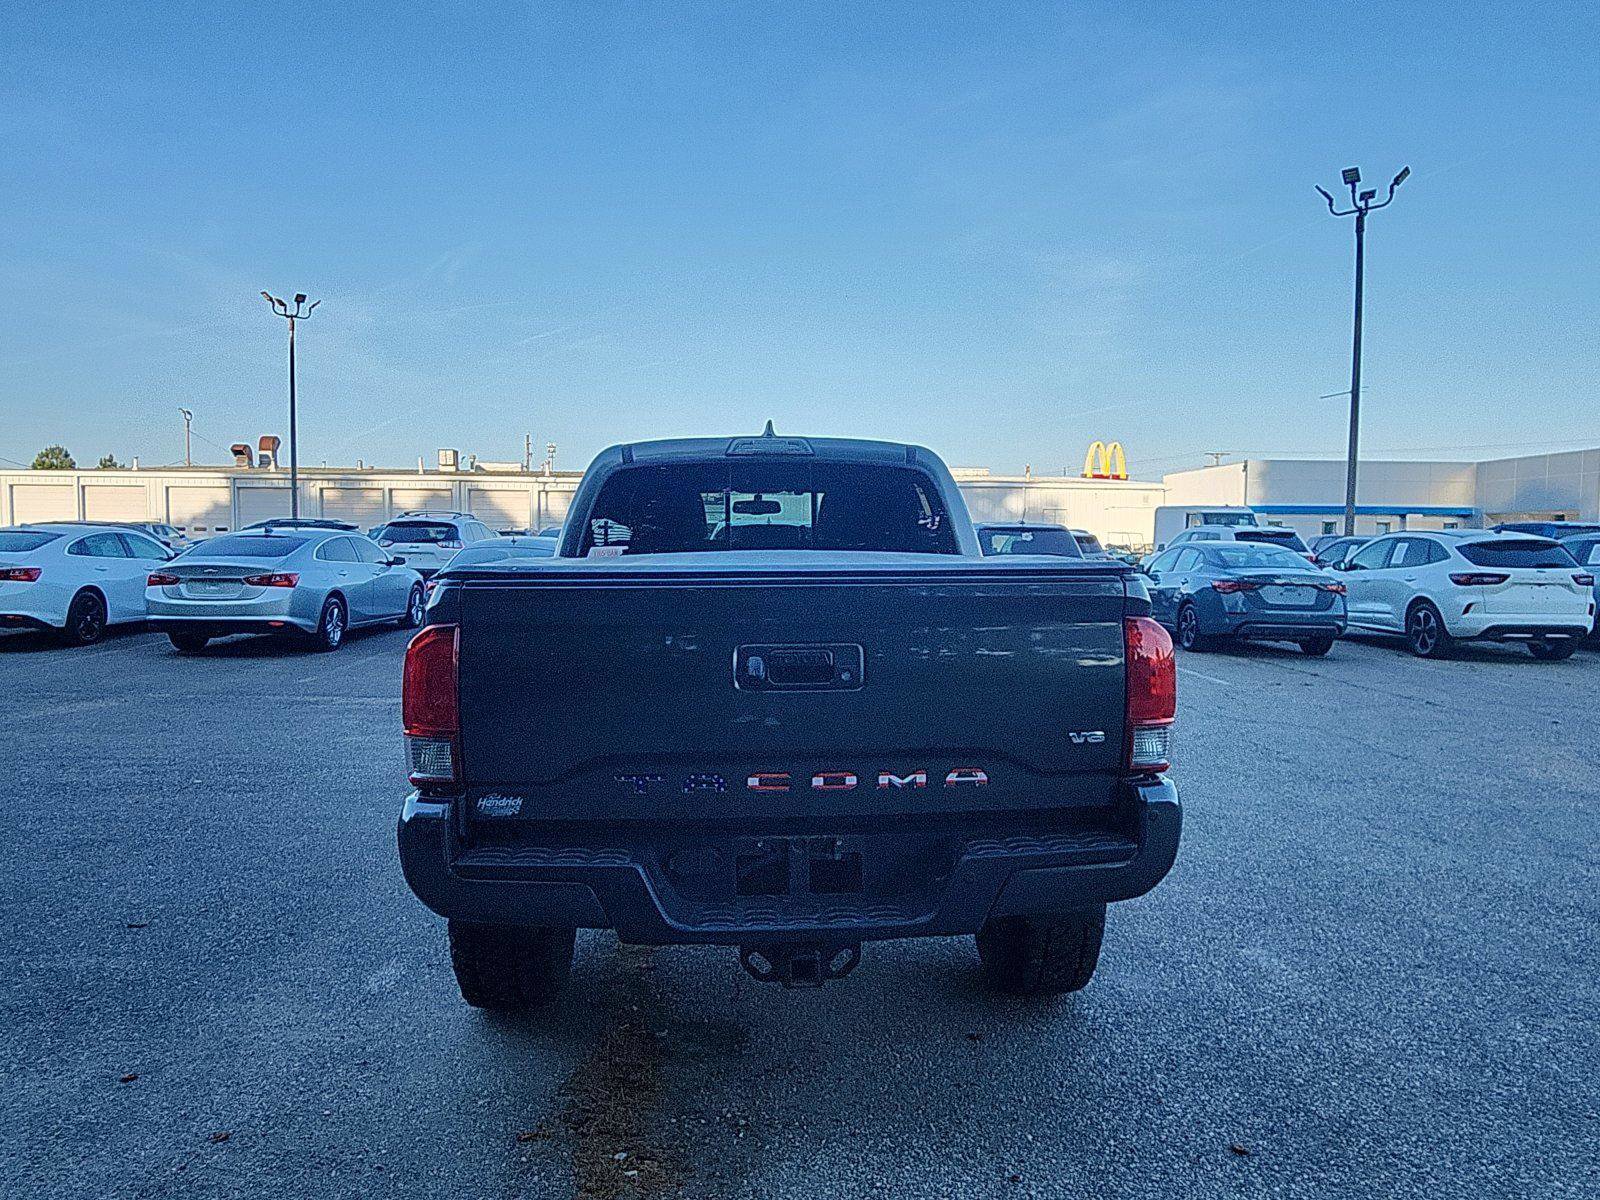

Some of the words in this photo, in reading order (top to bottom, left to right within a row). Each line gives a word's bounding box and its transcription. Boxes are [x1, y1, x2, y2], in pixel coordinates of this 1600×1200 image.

[1069, 731, 1105, 743] V6
[614, 768, 988, 794] TACOMA
[476, 796, 523, 810] Hendrick
